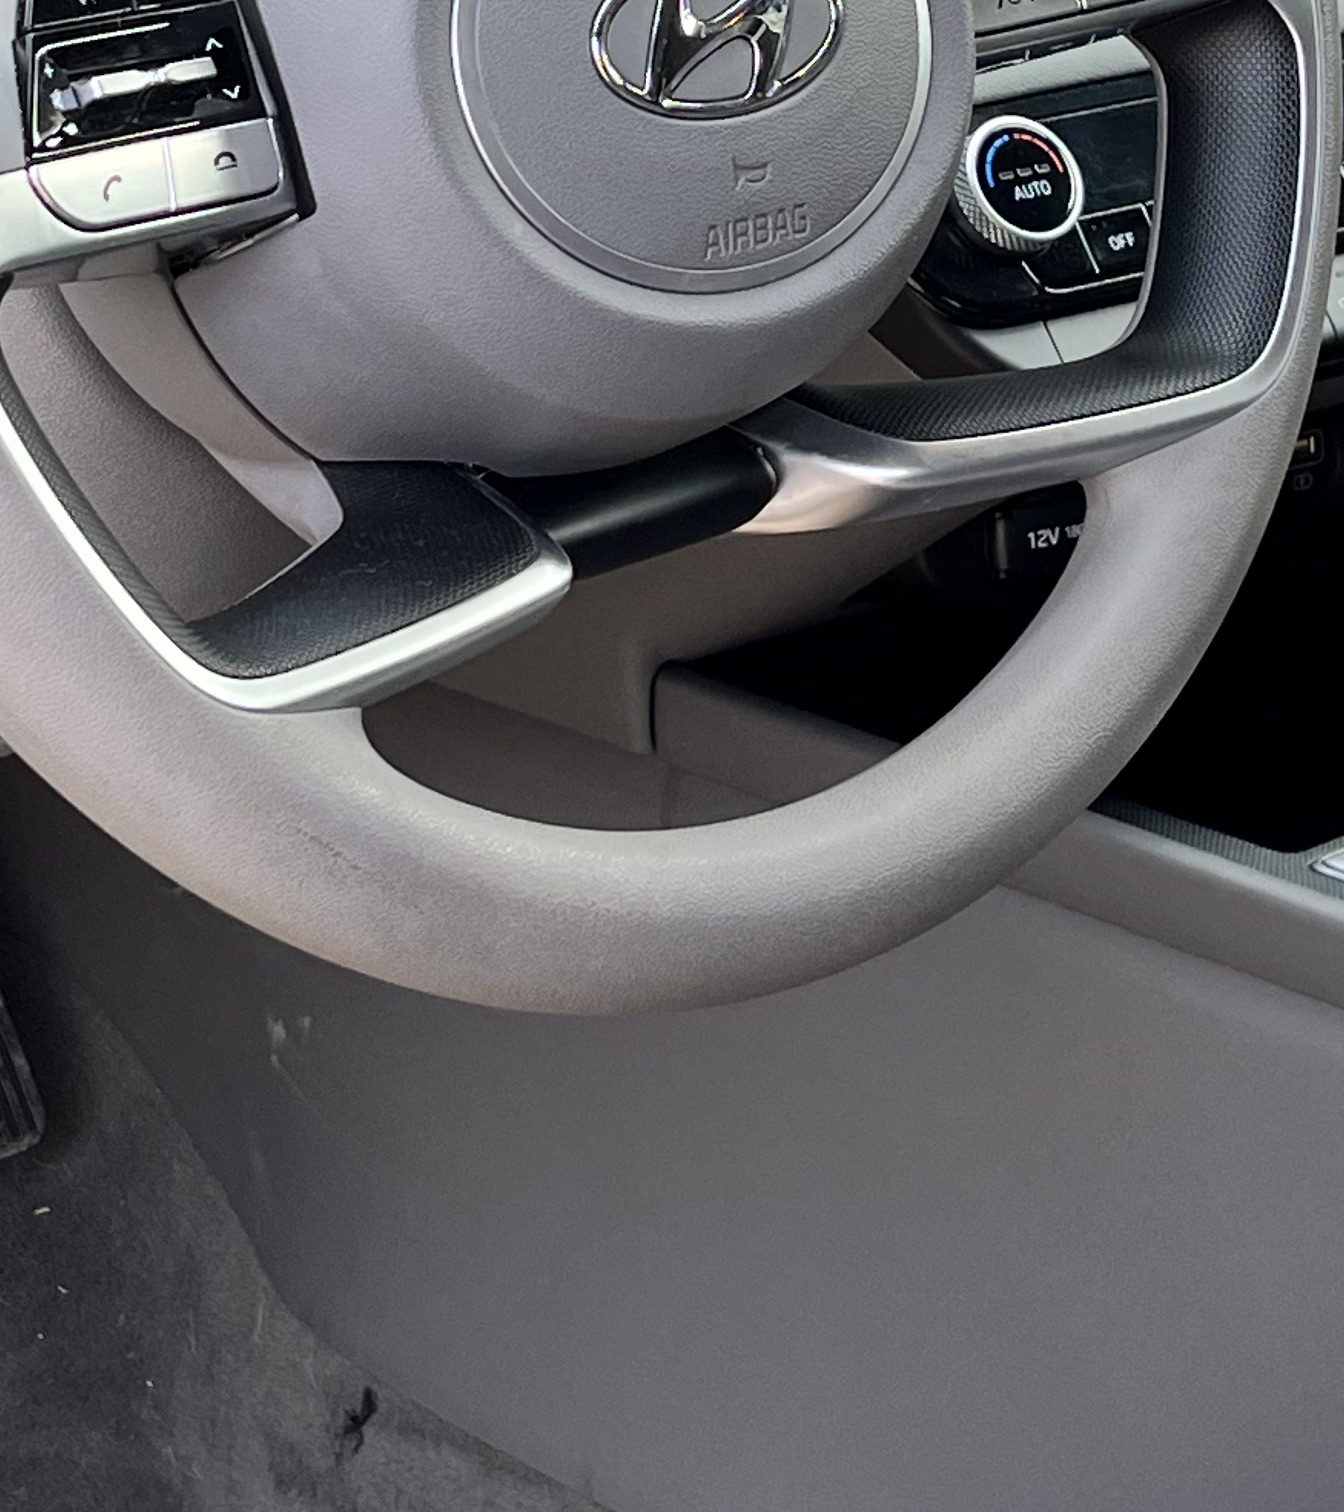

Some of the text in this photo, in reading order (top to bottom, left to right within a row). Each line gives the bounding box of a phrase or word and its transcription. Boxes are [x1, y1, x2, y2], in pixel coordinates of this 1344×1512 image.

[1013, 179, 1052, 201] AUTO
[704, 202, 812, 261] AIRBAG
[1107, 231, 1136, 252] OFF
[1026, 525, 1061, 550] 12V
